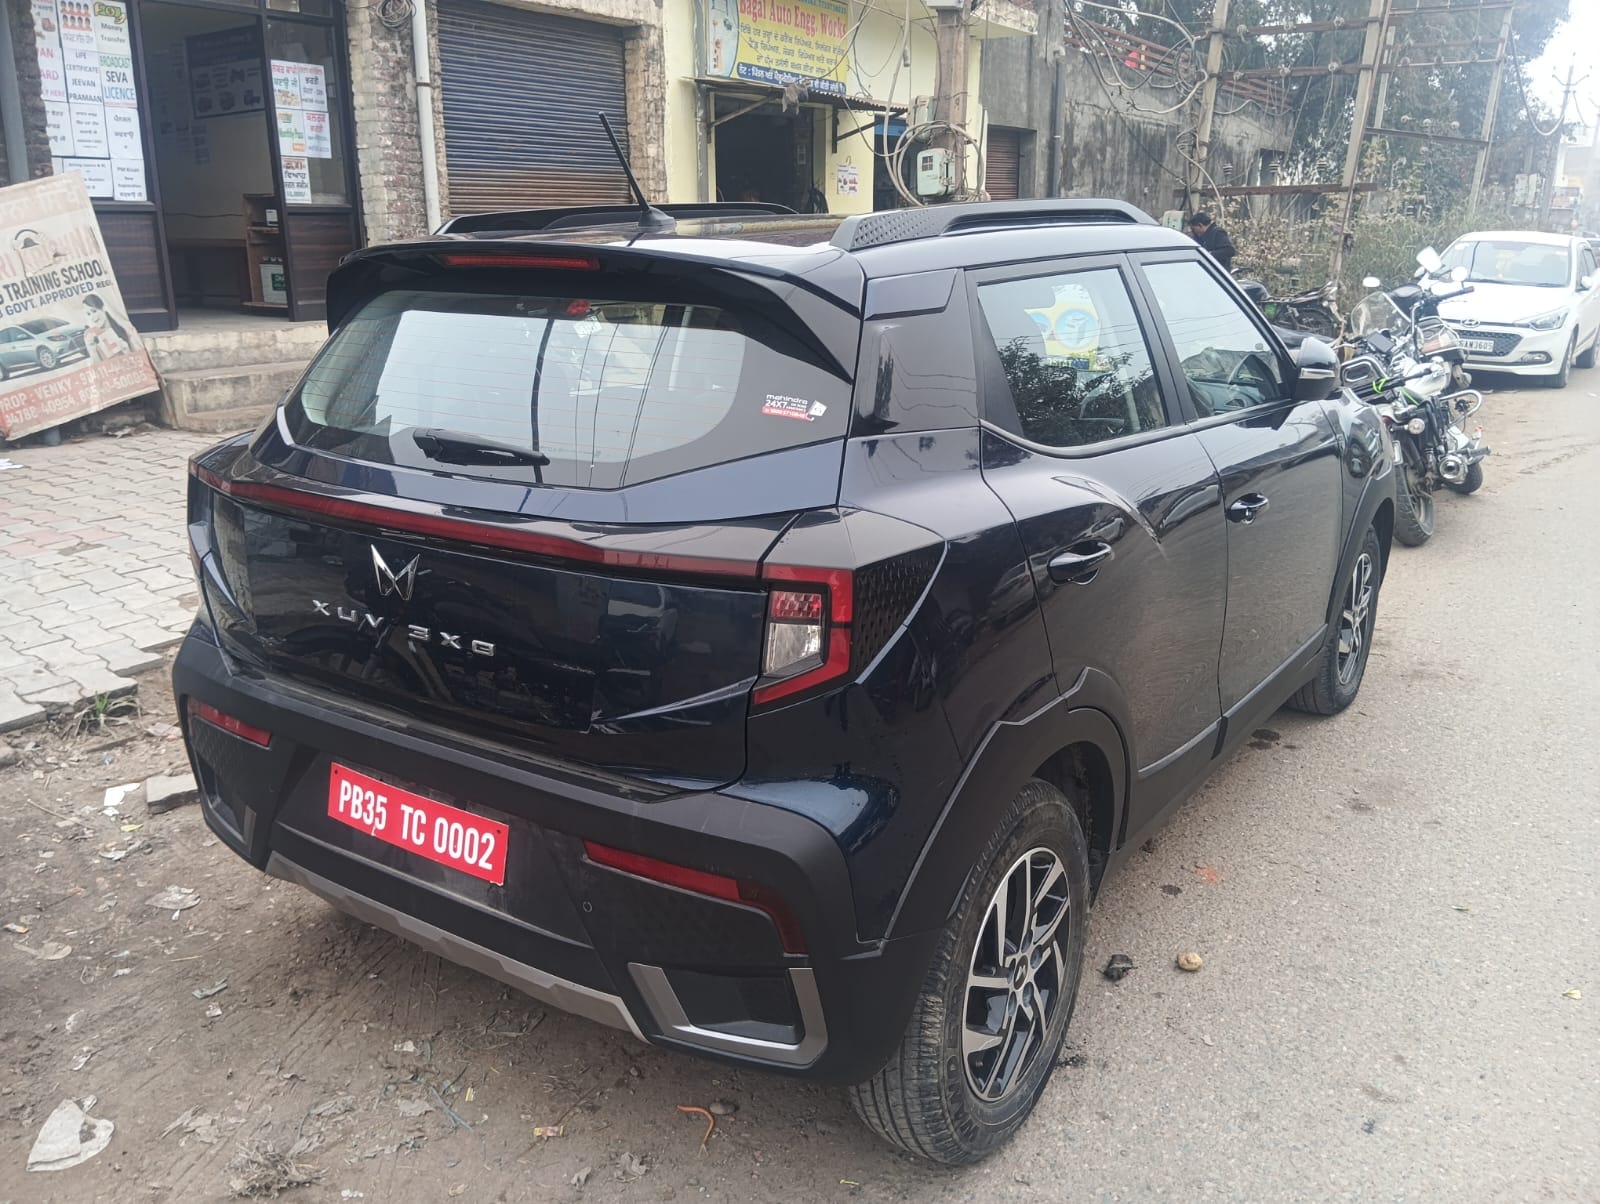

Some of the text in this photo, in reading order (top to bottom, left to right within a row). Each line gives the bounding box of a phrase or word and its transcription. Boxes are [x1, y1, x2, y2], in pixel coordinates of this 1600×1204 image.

[769, 0, 792, 26] Auto
[820, 12, 847, 40] Works
[101, 23, 123, 32] Money
[101, 34, 126, 43] Transfer
[37, 47, 54, 58] AN
[75, 50, 88, 59] LIFE
[99, 55, 131, 68] BROADCAST
[40, 69, 60, 80] ARD
[66, 64, 99, 73] CERTIFICATE
[72, 78, 96, 87] JEEVAN
[105, 70, 129, 83] SEVA
[69, 93, 103, 103] PRAMAAN
[104, 86, 136, 100] LICENCE
[3, 270, 61, 302] TRAINING
[40, 281, 95, 307] APPROVED
[34, 378, 74, 400] VENKY
[766, 394, 808, 405] mahindra
[312, 599, 384, 628] XUV
[338, 779, 496, 871] PB35 TC 0002
